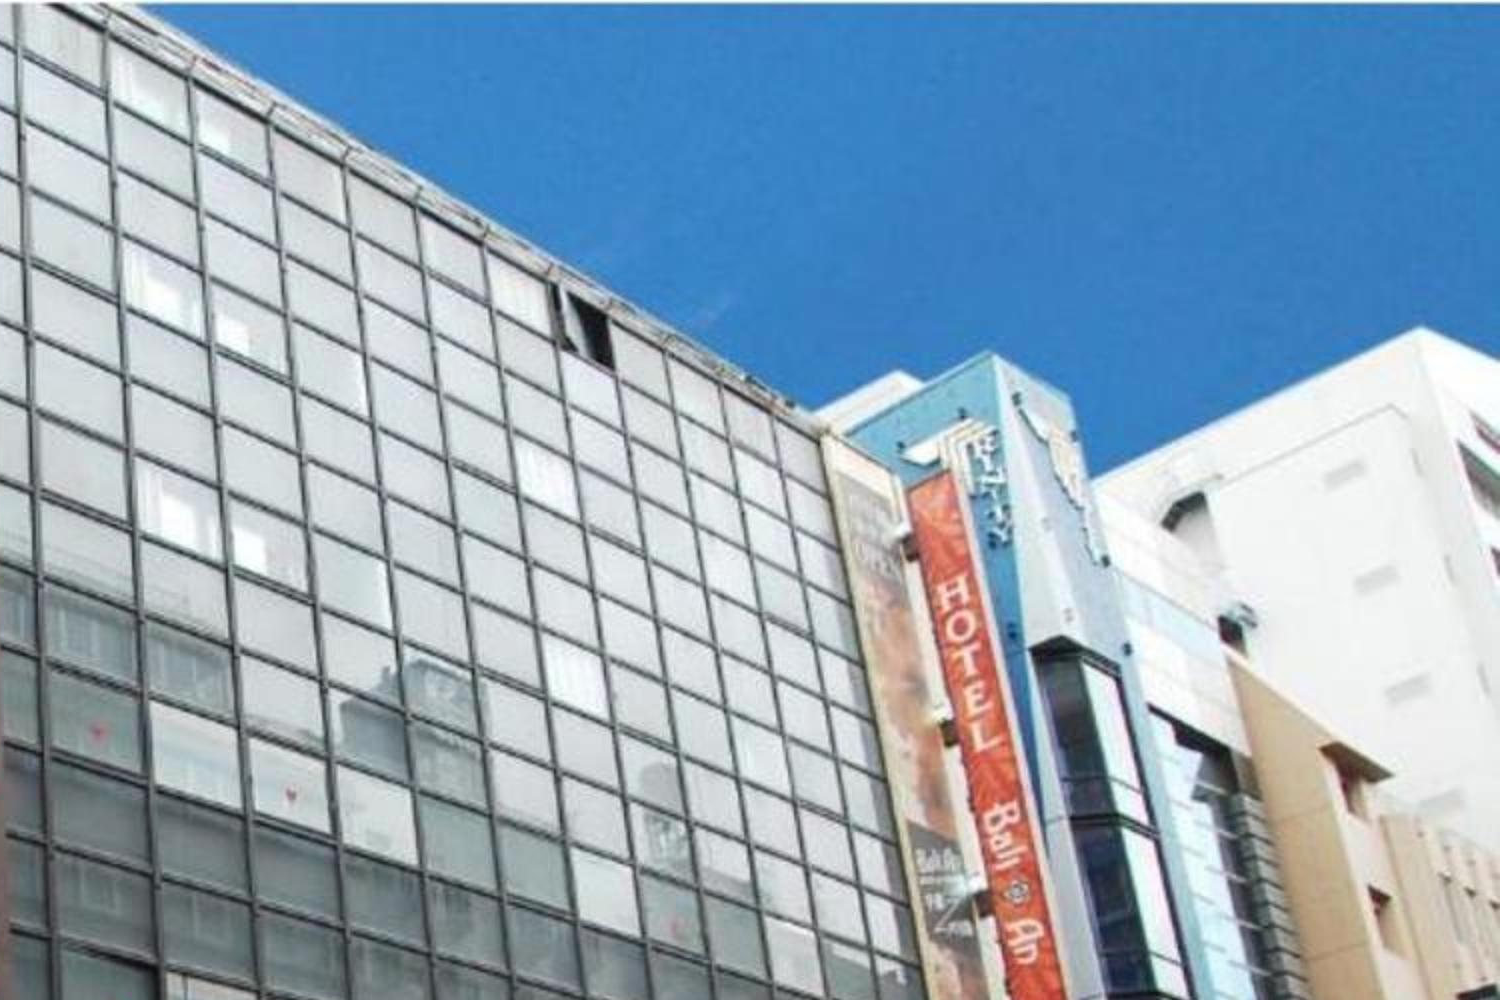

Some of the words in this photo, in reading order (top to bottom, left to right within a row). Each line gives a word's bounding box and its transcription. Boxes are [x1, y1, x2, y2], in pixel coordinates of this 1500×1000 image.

[937, 574, 999, 752] HOTEL
[984, 802, 1030, 874] Bali
[1005, 918, 1045, 965] An
